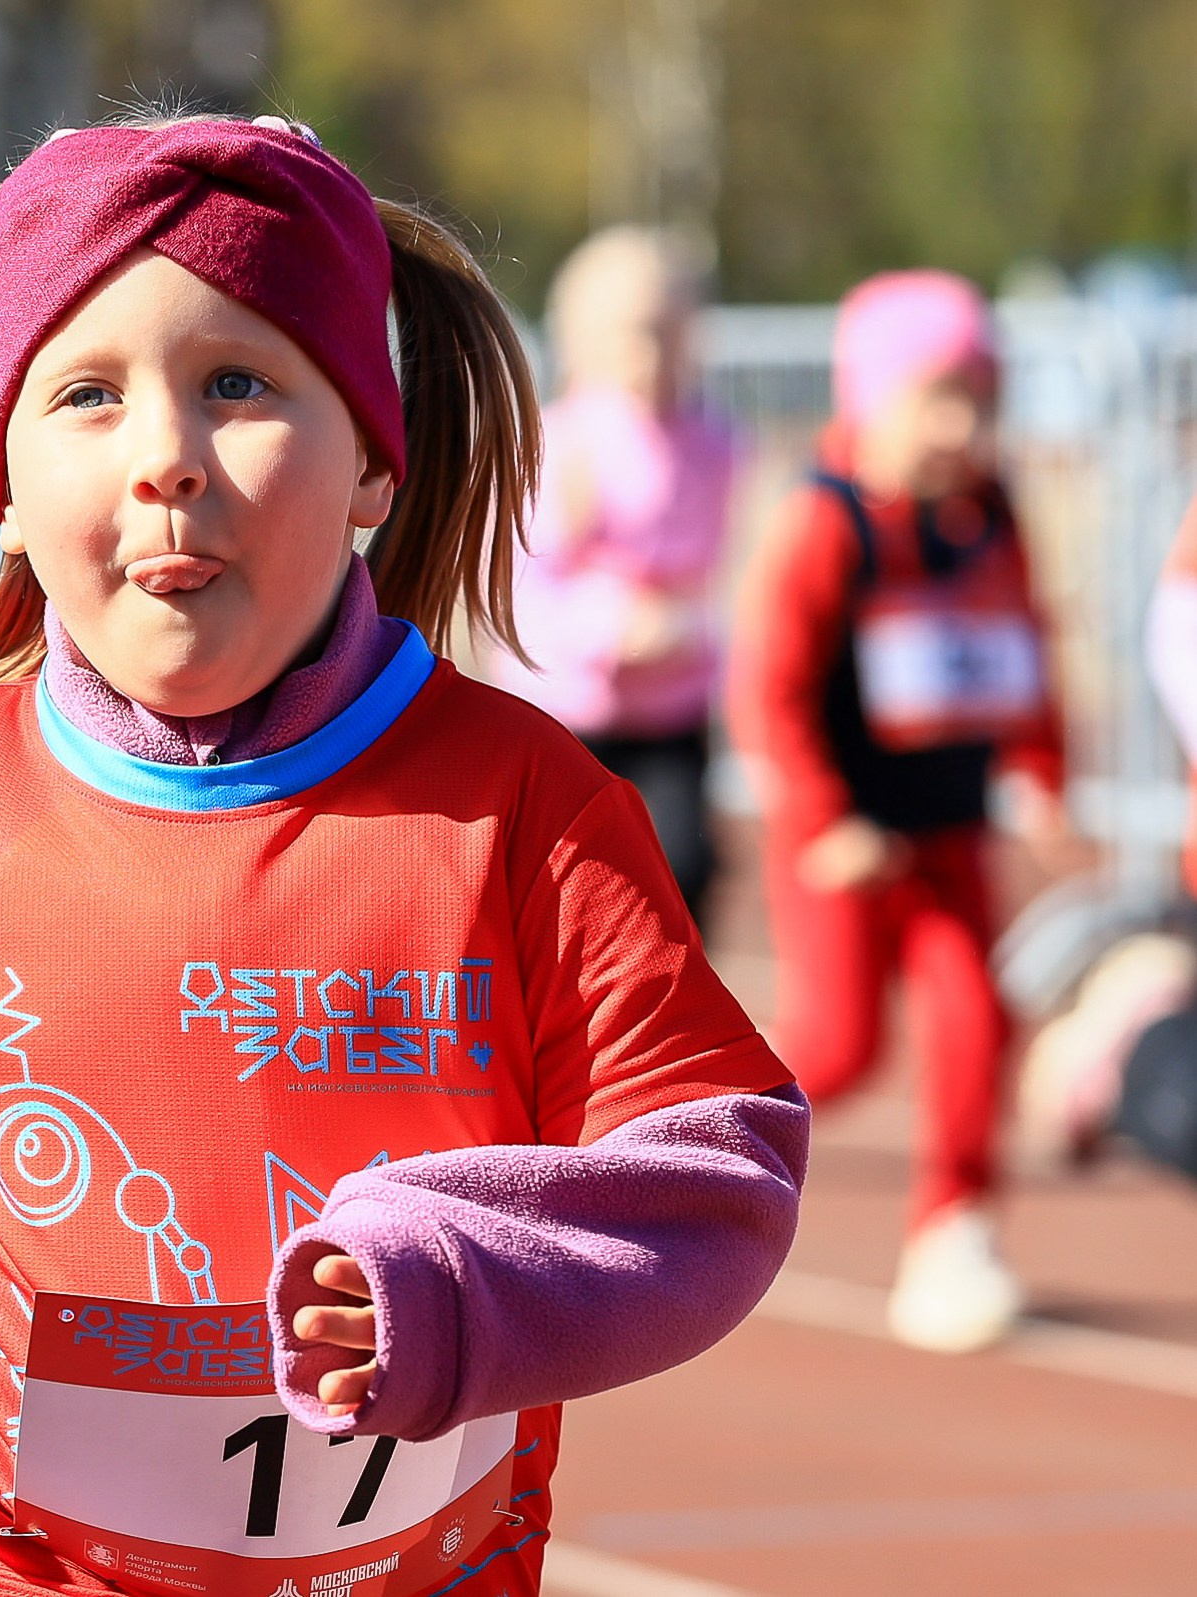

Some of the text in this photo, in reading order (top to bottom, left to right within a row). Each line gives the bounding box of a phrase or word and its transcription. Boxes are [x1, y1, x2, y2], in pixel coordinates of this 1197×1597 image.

[179, 958, 493, 1032] ДЕТСКИЙ
[233, 1025, 457, 1082] ЗАБЕГ
[287, 1083, 304, 1093] НА
[307, 1083, 398, 1094] МОСКОВСКОМ
[74, 1305, 273, 1347] ДЕТСК
[149, 1377, 163, 1385] НА
[165, 1378, 240, 1388] МОСКОВСКОМ
[222, 1413, 400, 1537] 17
[125, 1552, 198, 1573] Департамент
[125, 1561, 163, 1575] спорта
[310, 1551, 400, 1591] МОСКОВСКИЙ
[125, 1568, 207, 1592] города Москвы
